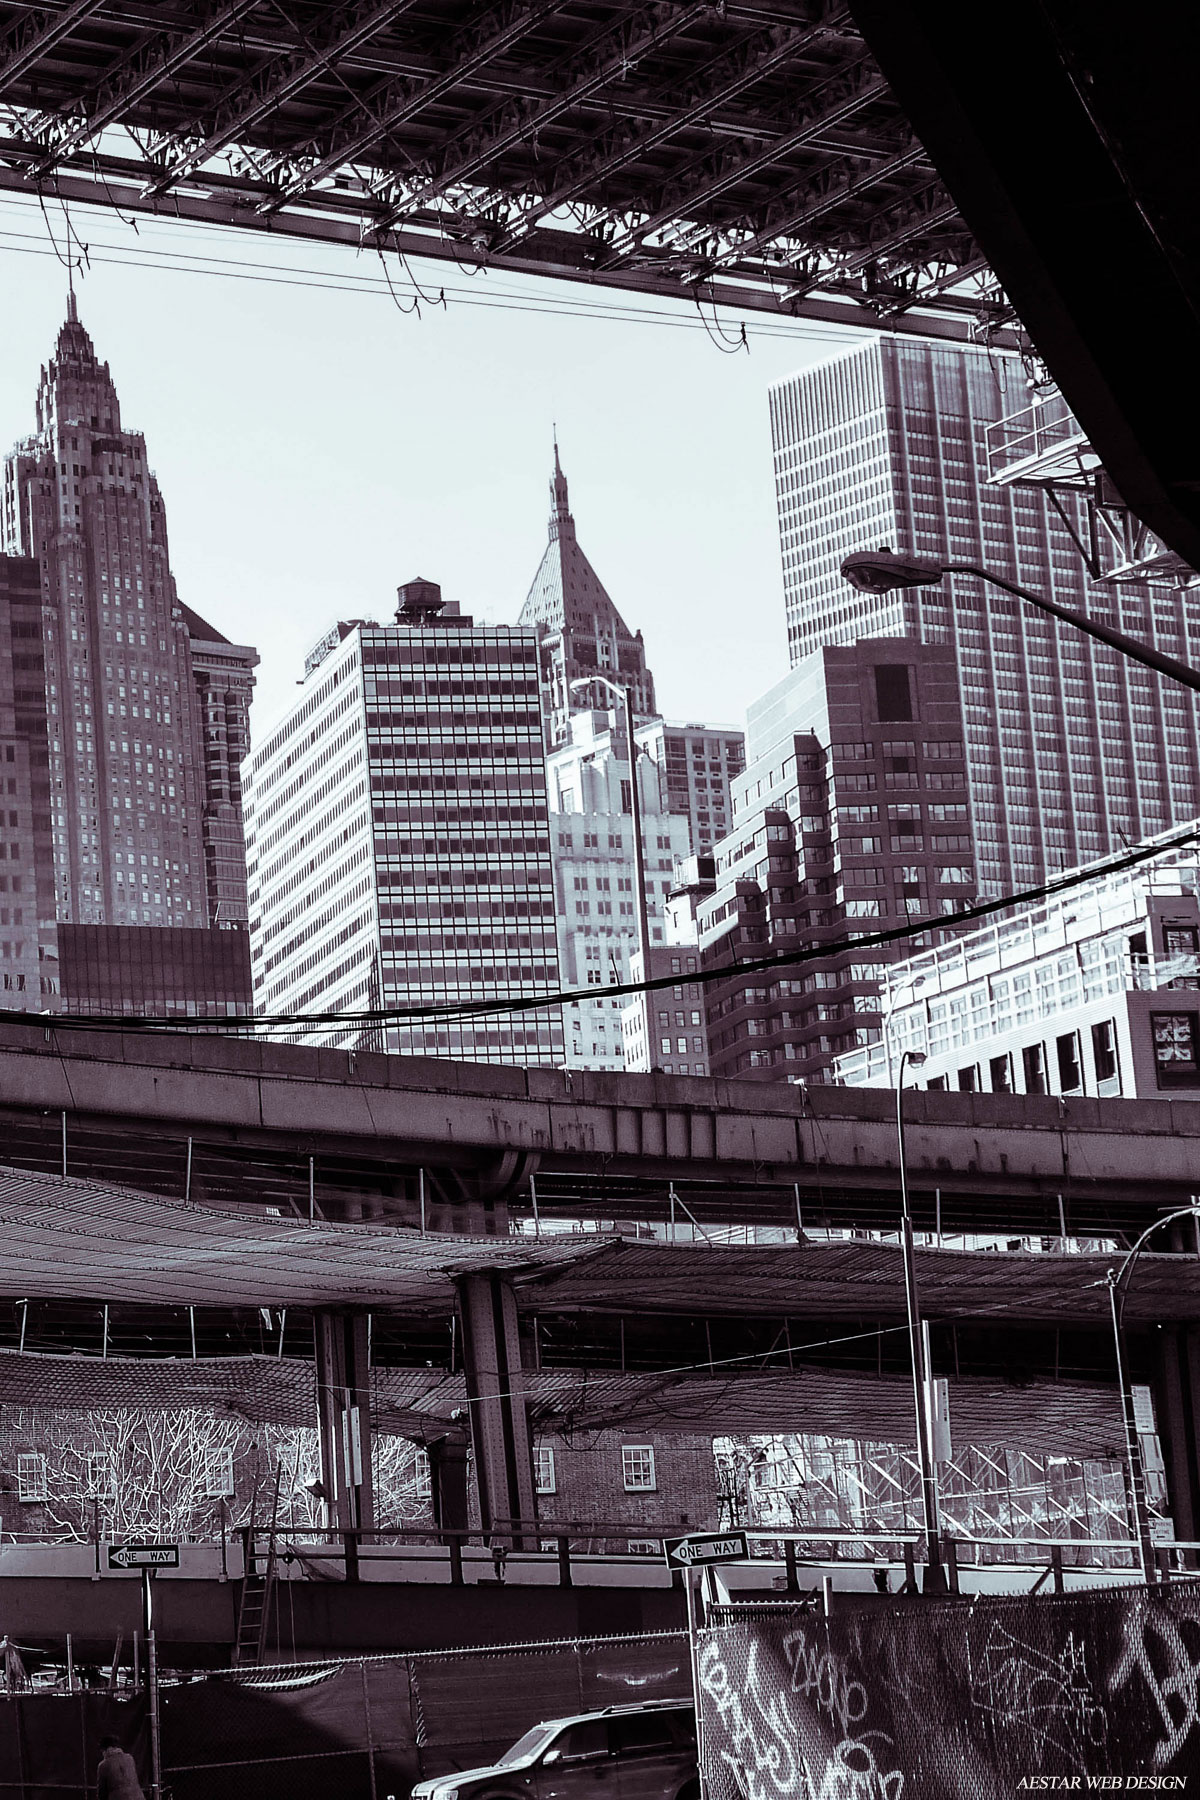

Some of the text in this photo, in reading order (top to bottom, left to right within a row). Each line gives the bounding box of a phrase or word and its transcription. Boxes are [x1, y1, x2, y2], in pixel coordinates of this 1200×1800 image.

[117, 1551, 171, 1562] ONE WAY
[680, 1541, 737, 1559] ONE WAY
